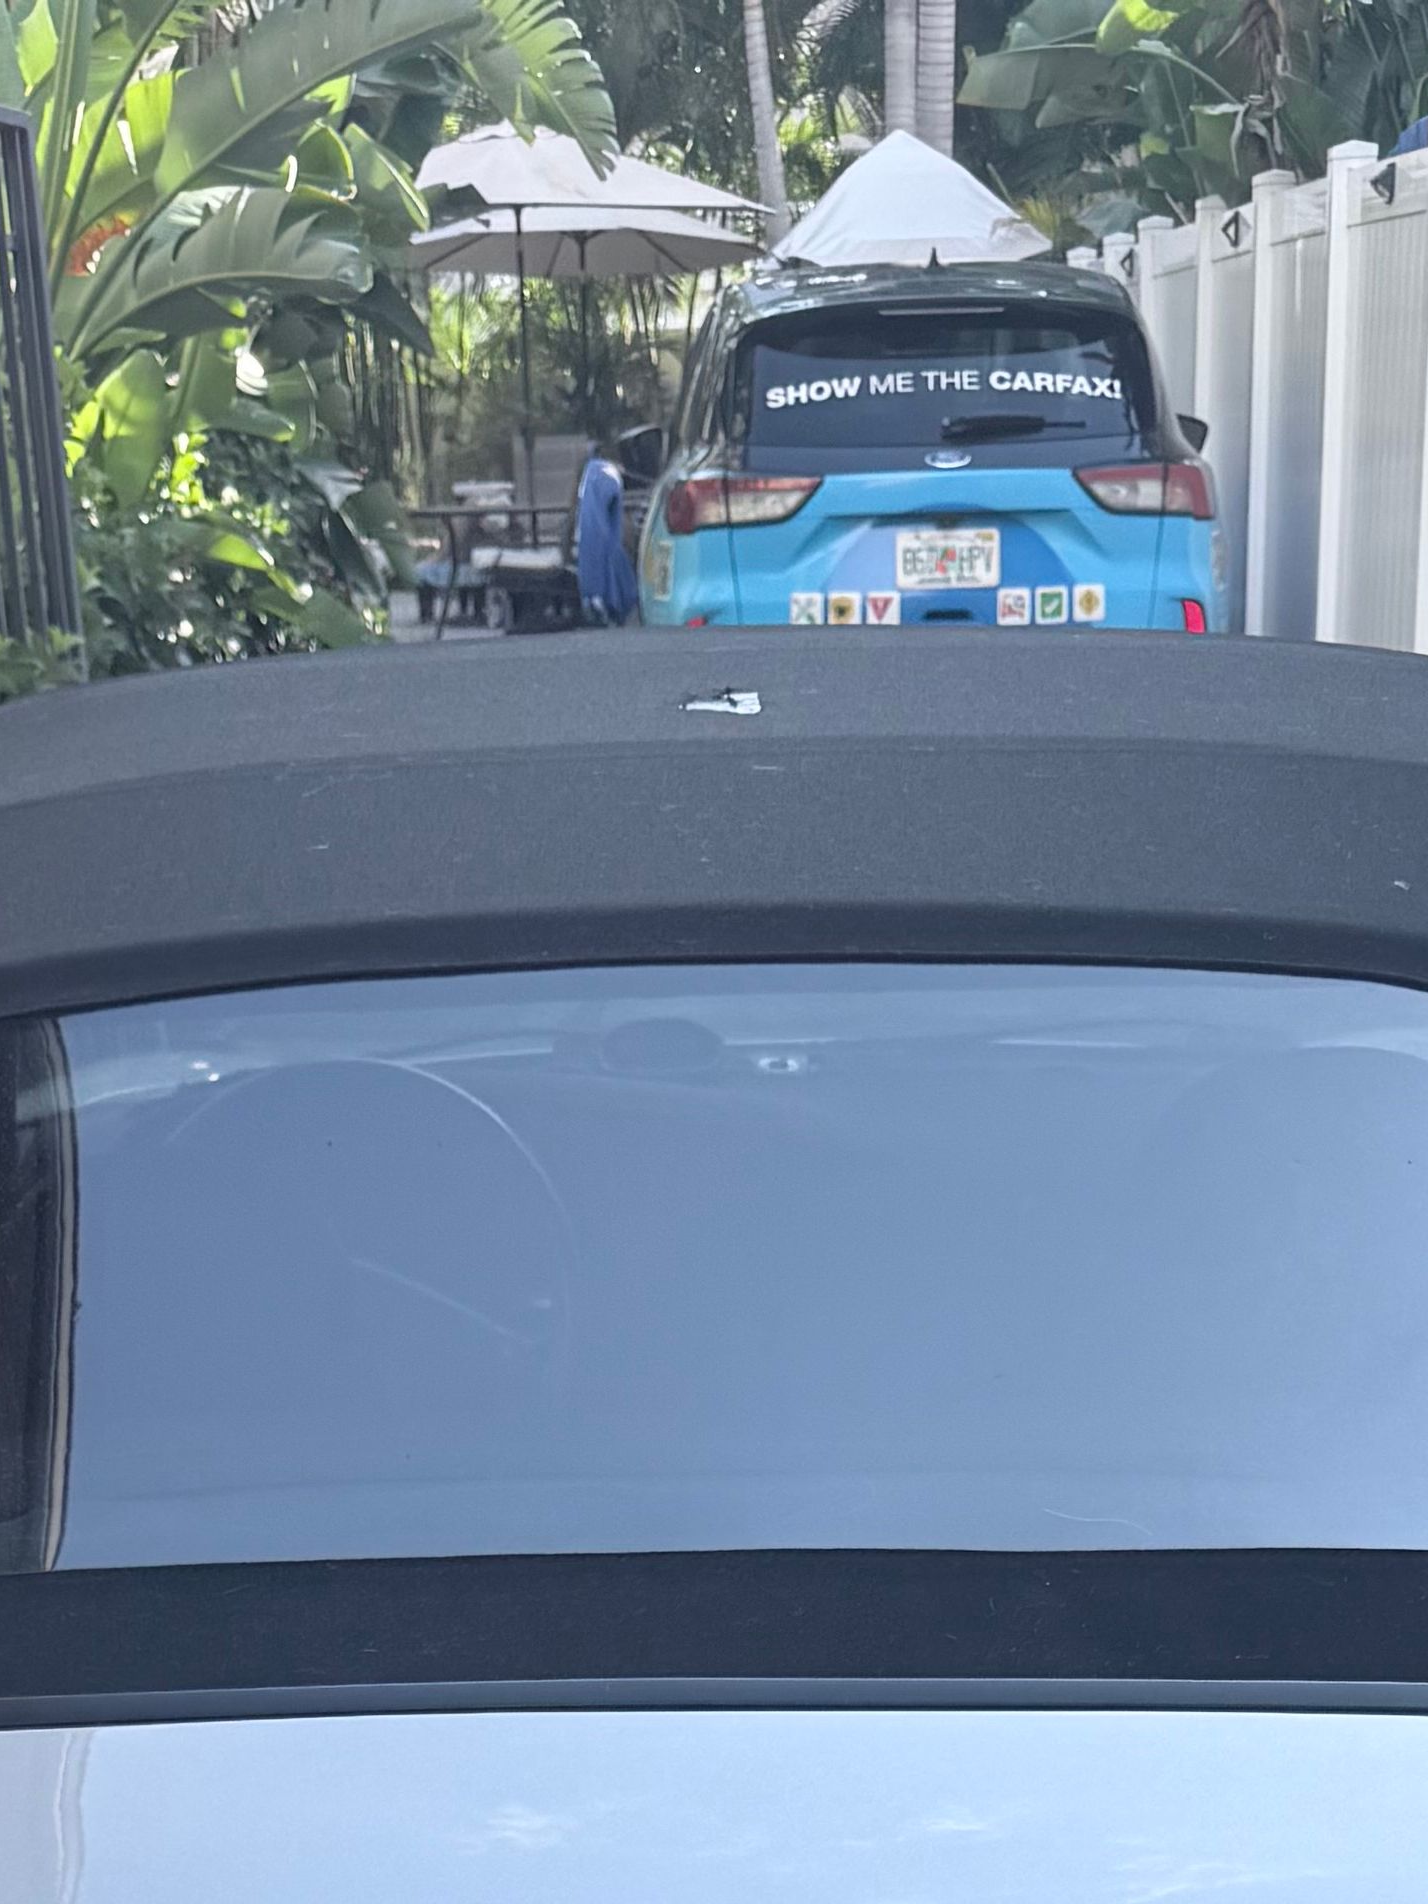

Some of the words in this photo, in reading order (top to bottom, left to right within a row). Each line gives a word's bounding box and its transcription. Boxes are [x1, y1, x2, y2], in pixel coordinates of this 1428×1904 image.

[766, 376, 861, 408] SHOW
[868, 372, 914, 395] ME
[920, 370, 981, 391] THE
[989, 370, 1123, 399] CARFAX!
